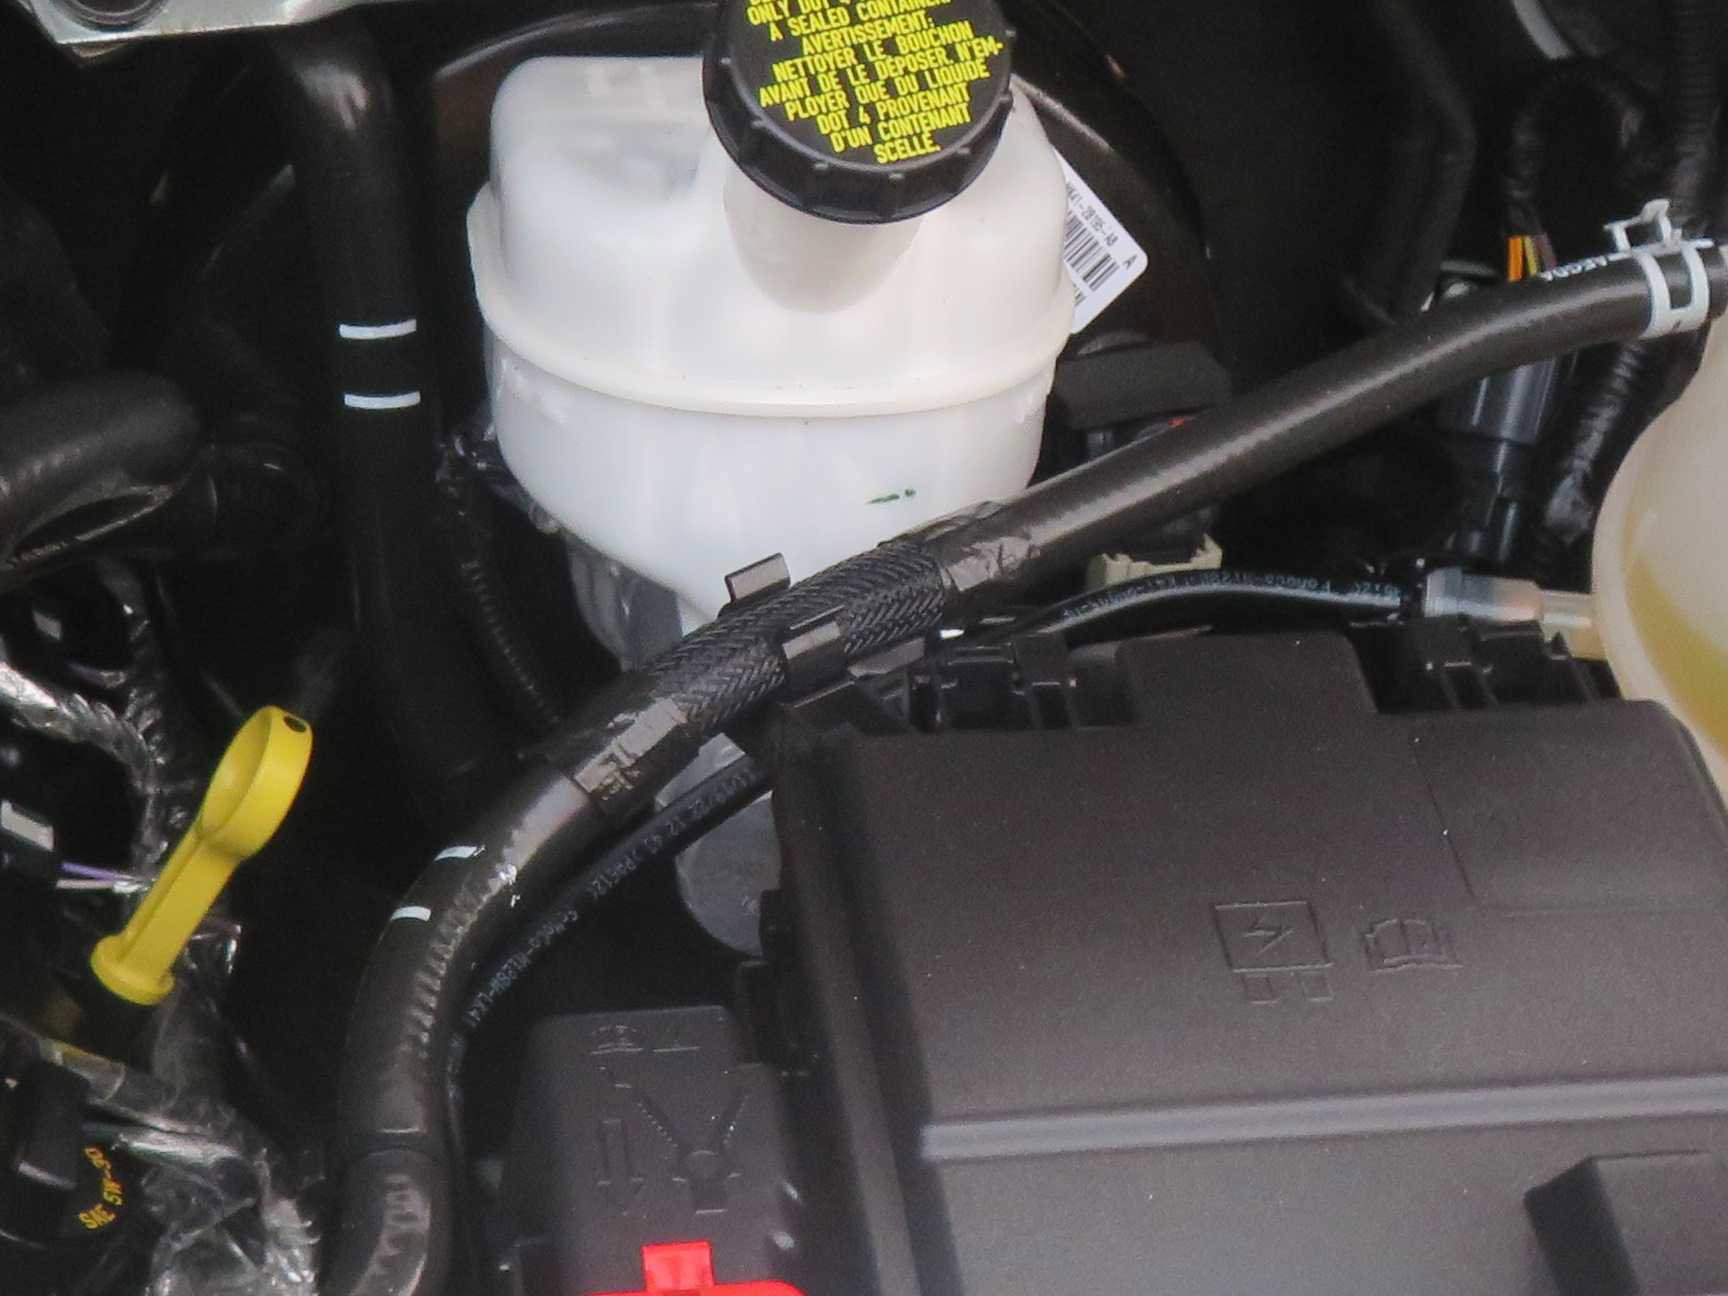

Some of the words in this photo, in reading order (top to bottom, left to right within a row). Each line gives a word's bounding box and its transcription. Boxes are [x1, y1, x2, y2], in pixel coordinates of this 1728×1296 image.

[747, 0, 790, 25] ONLY
[769, 22, 783, 42] A
[787, 7, 850, 36] SEALED
[801, 10, 935, 56] AVERTISSEMENT:
[759, 77, 811, 108] AVANT
[818, 71, 842, 93] DE
[846, 64, 870, 87] LE
[955, 35, 1003, 61] N'EM-
[772, 47, 858, 83] NETTOYER
[863, 40, 885, 62] LE
[895, 20, 974, 54] BOUCHON
[784, 90, 850, 121] PLOYER
[855, 81, 890, 104] QUE
[895, 74, 920, 95] DU
[925, 58, 990, 89] LIQUIDE
[816, 111, 850, 134] DOT
[859, 105, 871, 124] 4
[875, 83, 970, 120] PROVENANT
[830, 126, 872, 152] D'UN
[878, 103, 971, 141] CONTENANT
[79, 1204, 116, 1229] SAE
